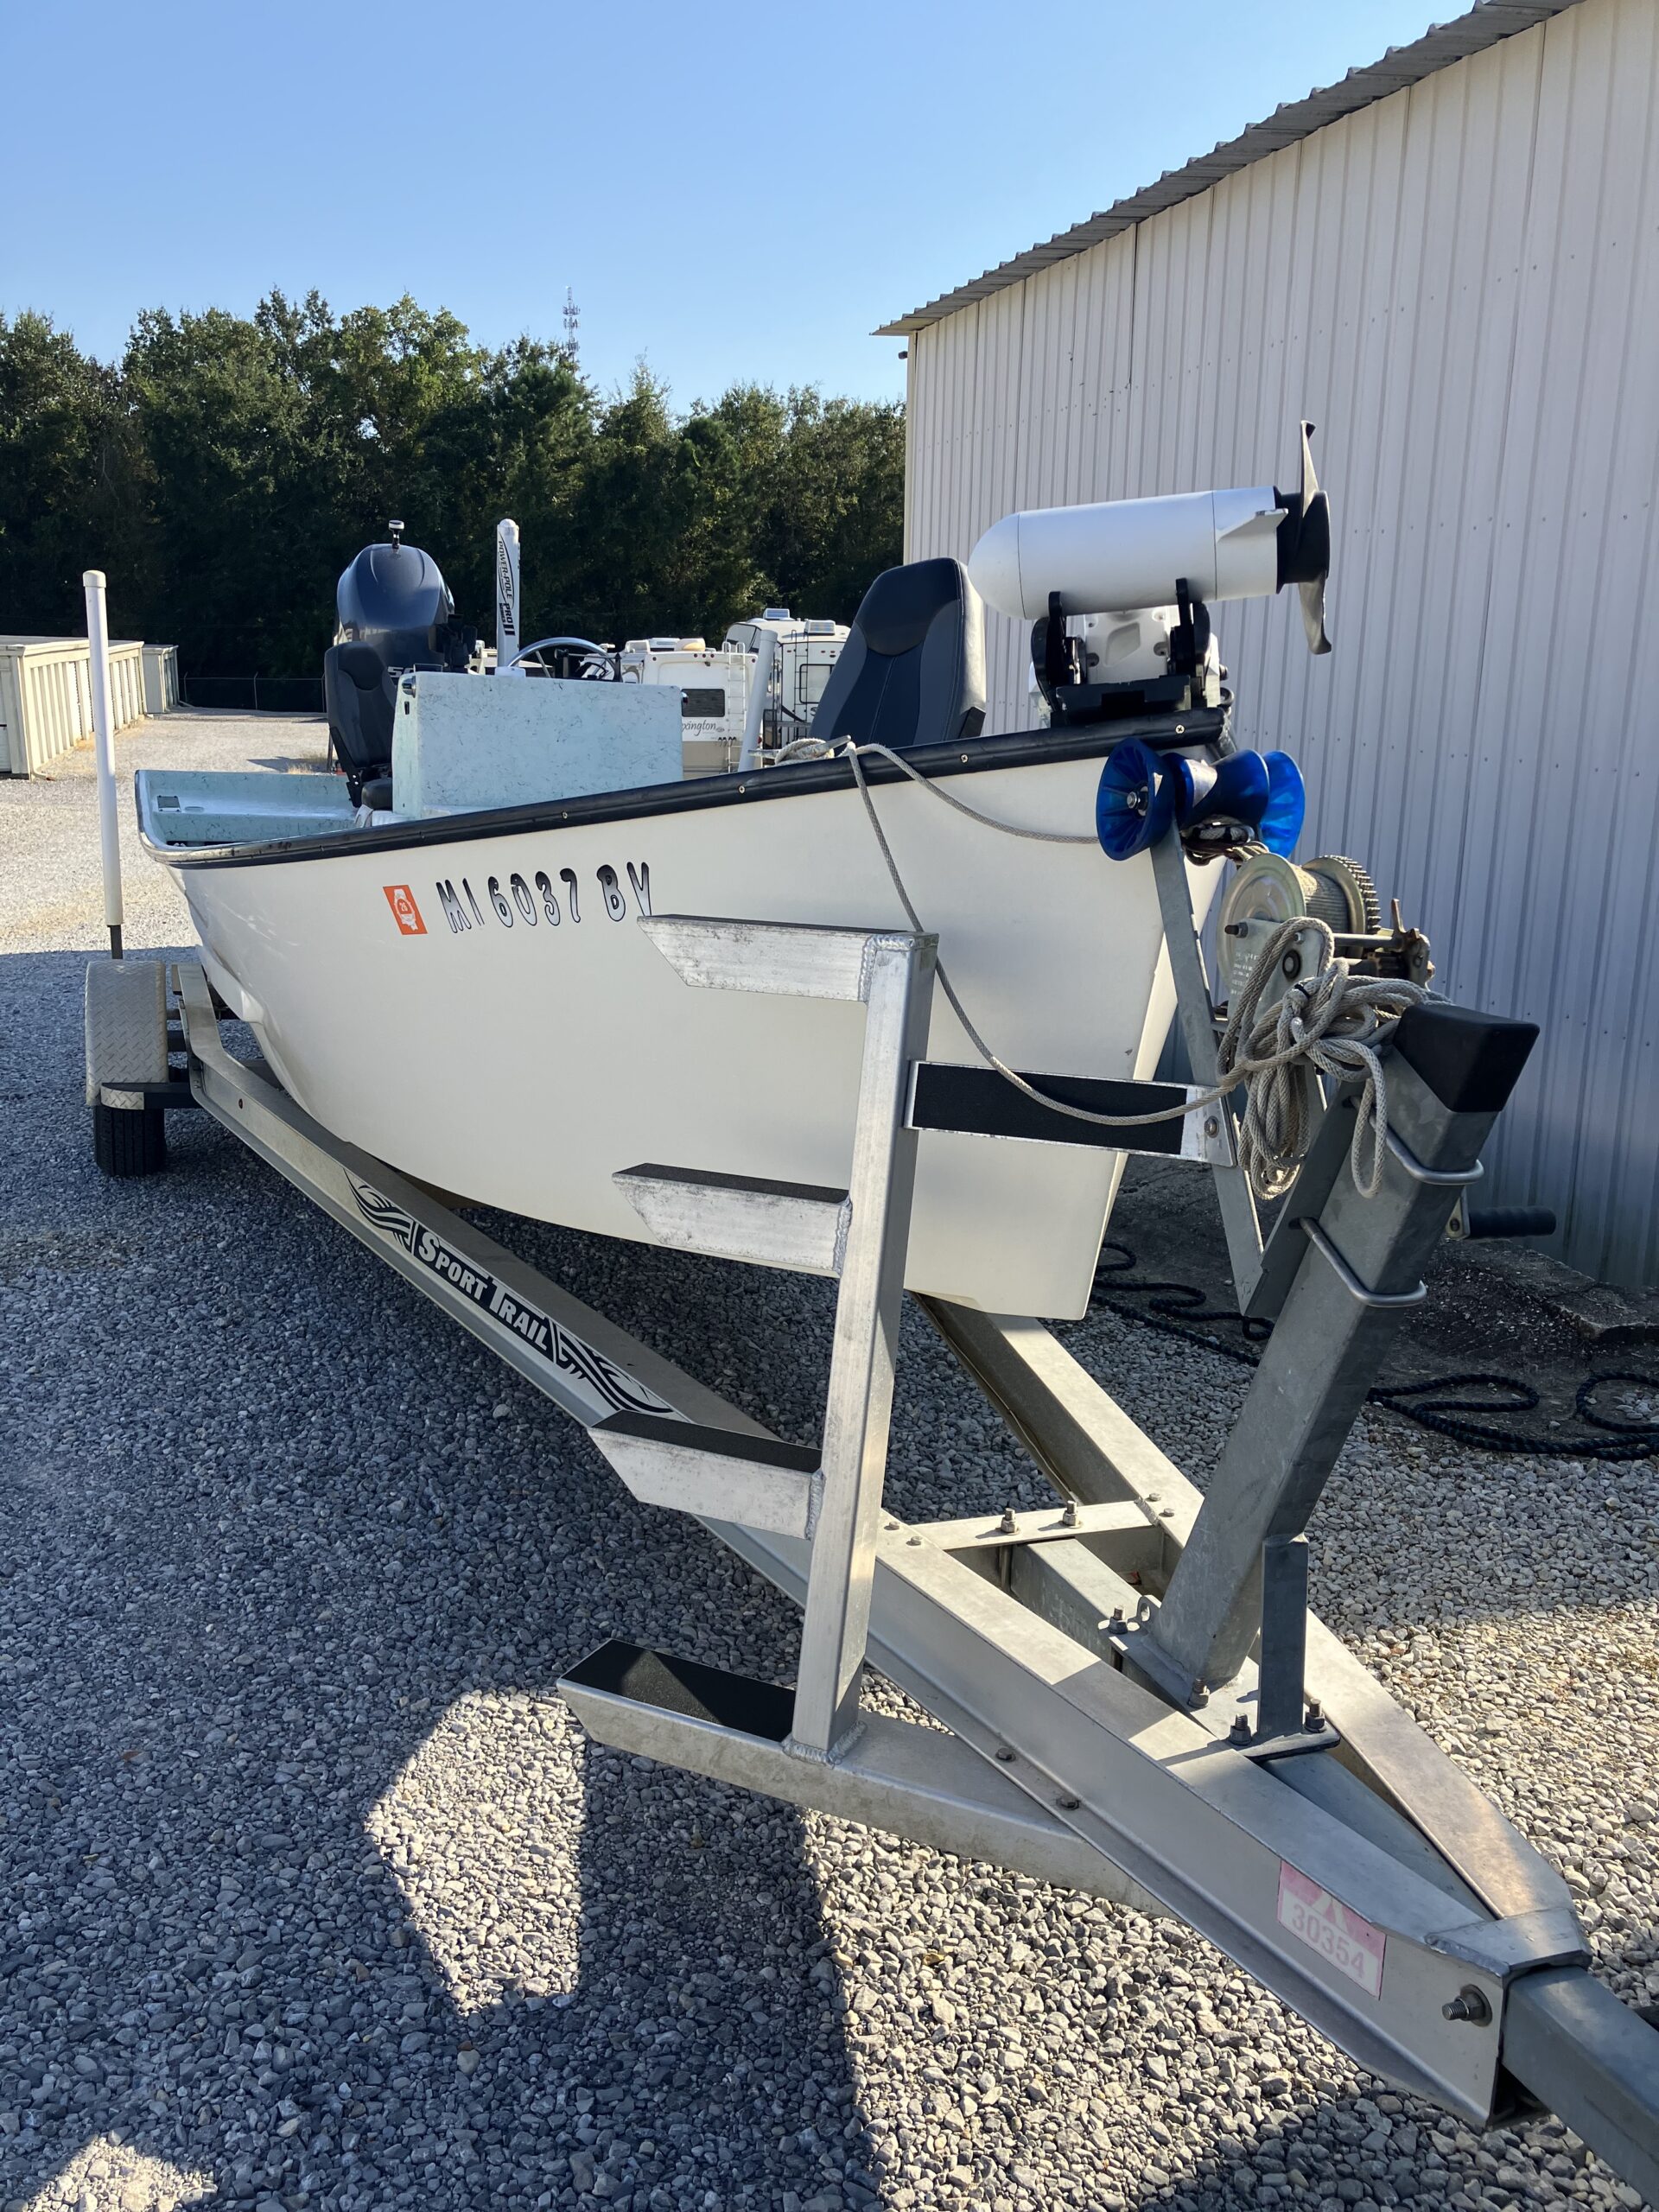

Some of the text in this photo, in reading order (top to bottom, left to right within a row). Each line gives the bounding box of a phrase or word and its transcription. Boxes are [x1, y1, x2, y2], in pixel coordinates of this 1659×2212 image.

[499, 540, 513, 599] POWER-POLE
[504, 602, 514, 623] PRO
[682, 719, 716, 736] xington
[435, 861, 652, 933] MI 6037 BV
[418, 1231, 549, 1351] SPORT TRAIL
[1292, 1904, 1366, 1979] 30354
